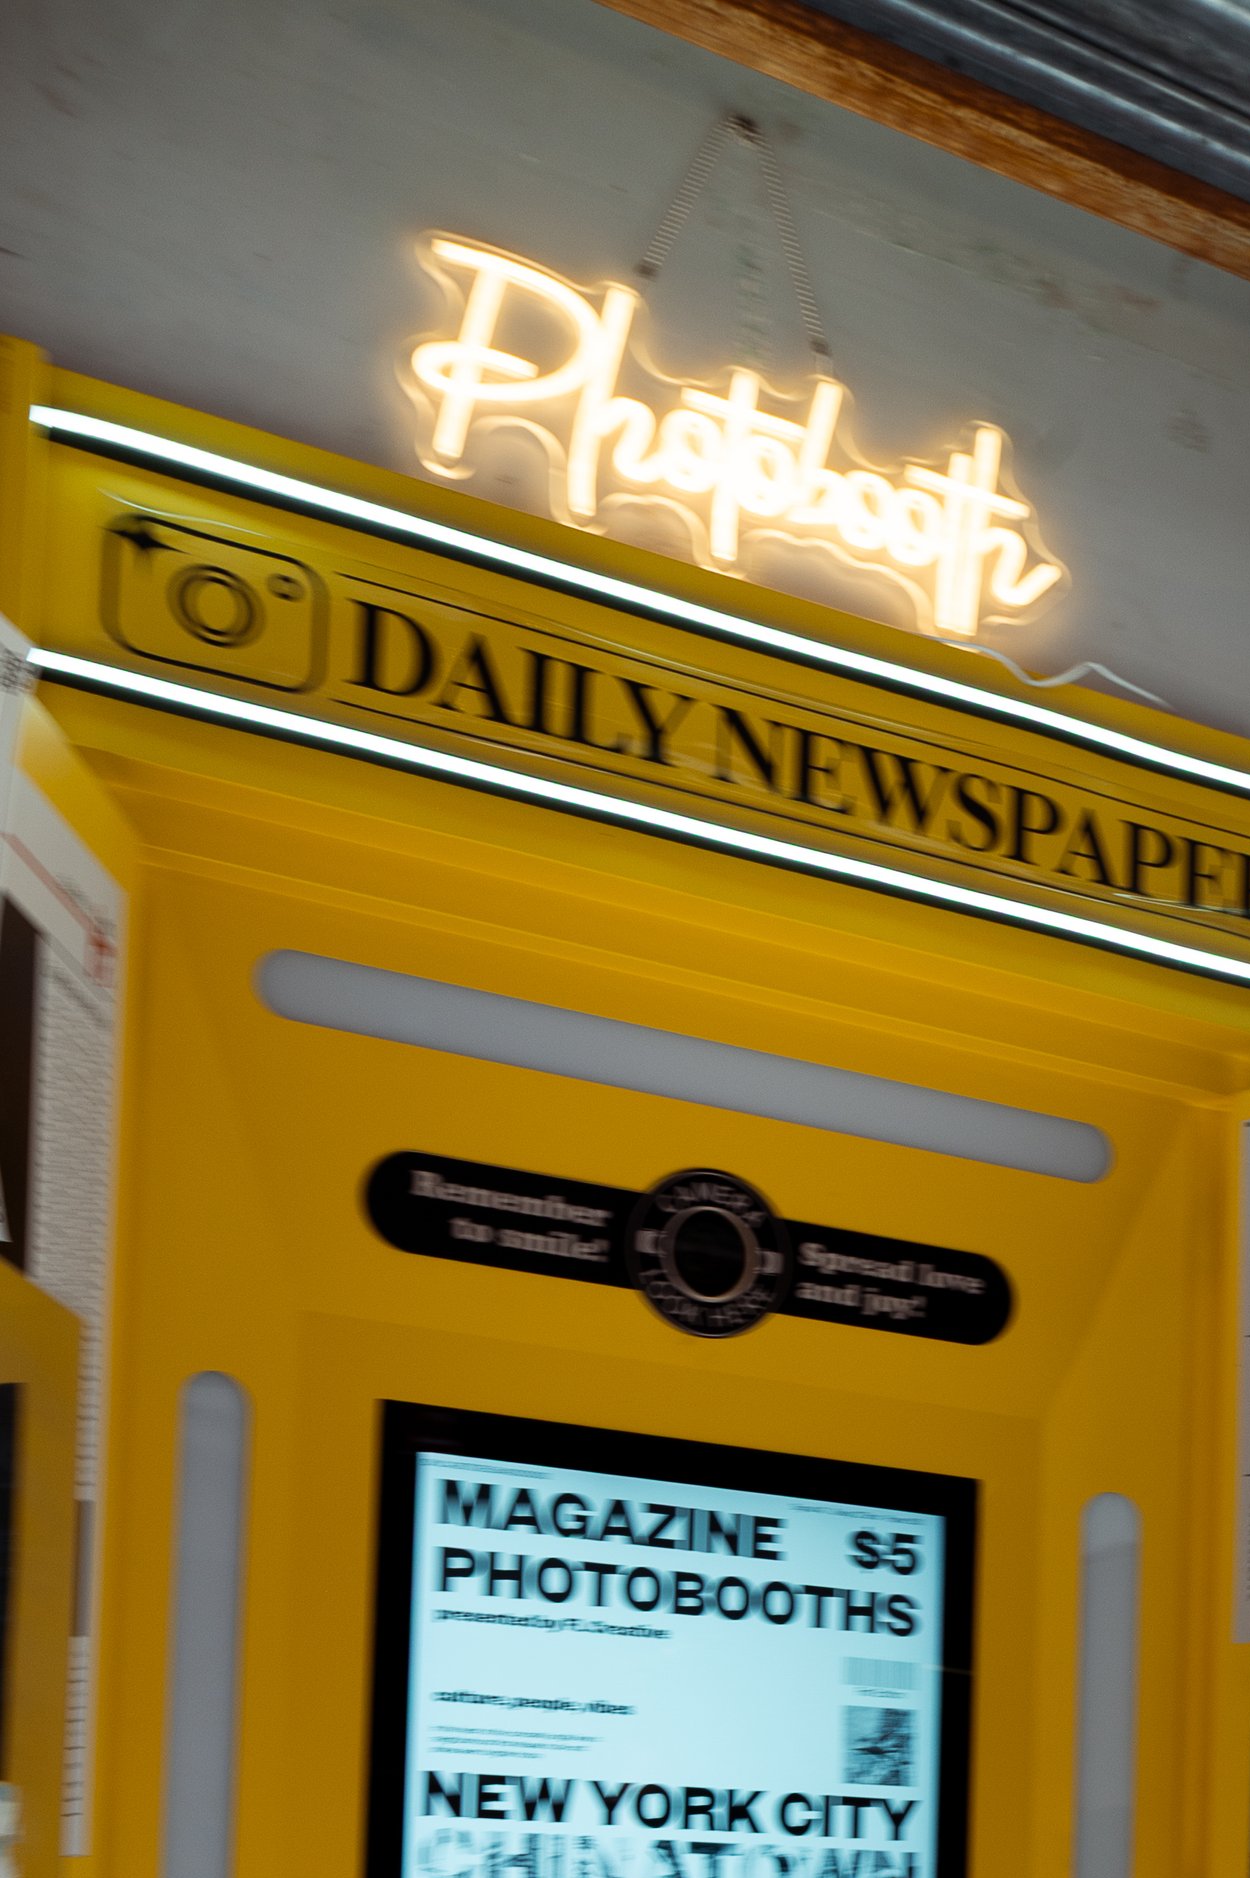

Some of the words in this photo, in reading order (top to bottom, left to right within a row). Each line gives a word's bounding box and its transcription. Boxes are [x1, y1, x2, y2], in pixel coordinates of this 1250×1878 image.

[353, 597, 695, 767] DAILY
[409, 1169, 612, 1228] Remember
[449, 1216, 494, 1243] to
[498, 1229, 609, 1264] smile!
[798, 1241, 915, 1285] Spread
[917, 1261, 986, 1296] love
[797, 1280, 857, 1308] and
[435, 1478, 787, 1562] MAGAZINE
[850, 1526, 925, 1577] $5
[436, 1545, 923, 1638] PHOTOBOOTHS
[421, 1770, 572, 1823] NEW
[590, 1780, 767, 1833] YORK
[778, 1792, 924, 1842] CITY
